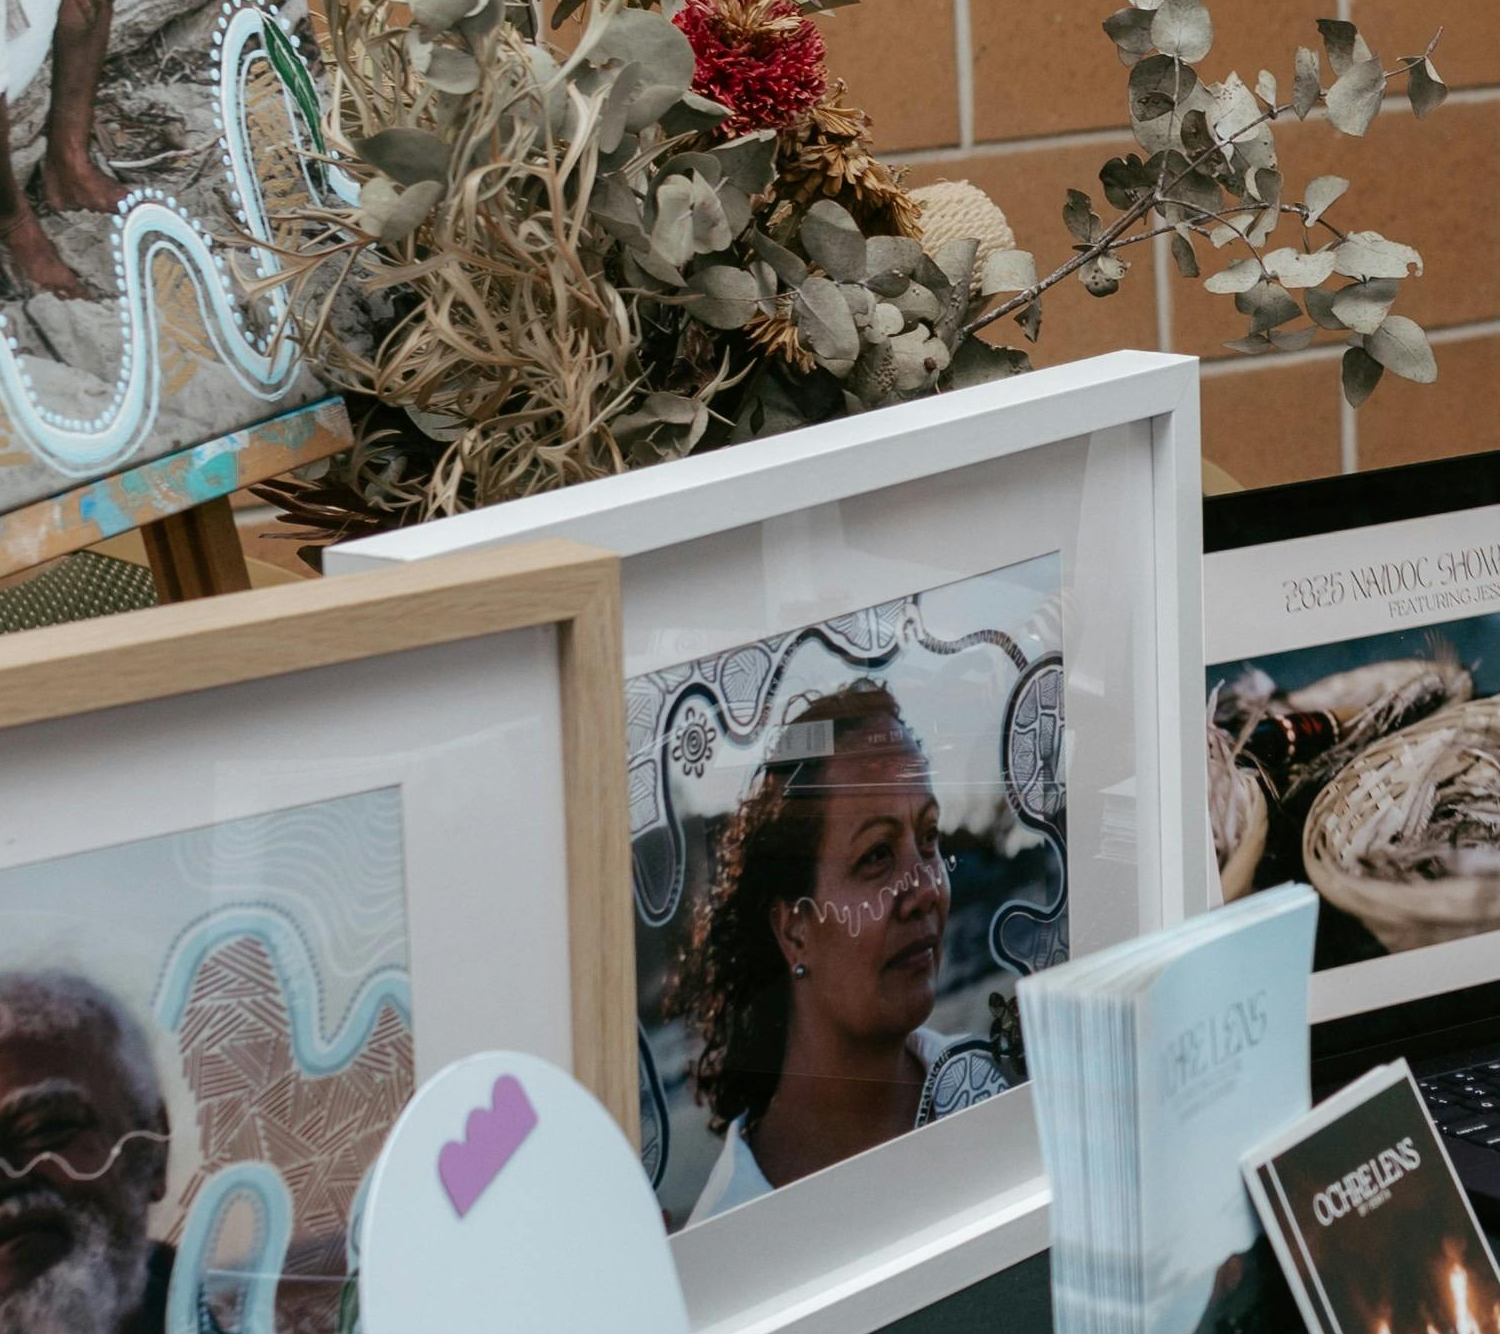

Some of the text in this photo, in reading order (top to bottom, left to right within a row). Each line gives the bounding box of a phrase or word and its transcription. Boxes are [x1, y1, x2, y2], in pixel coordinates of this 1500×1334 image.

[1282, 571, 1346, 614] 2025
[1350, 555, 1434, 603] NAIDOC
[1387, 586, 1473, 619] FEATURING
[1313, 1162, 1377, 1227] OCHRE
[1369, 1136, 1422, 1190] LENS
